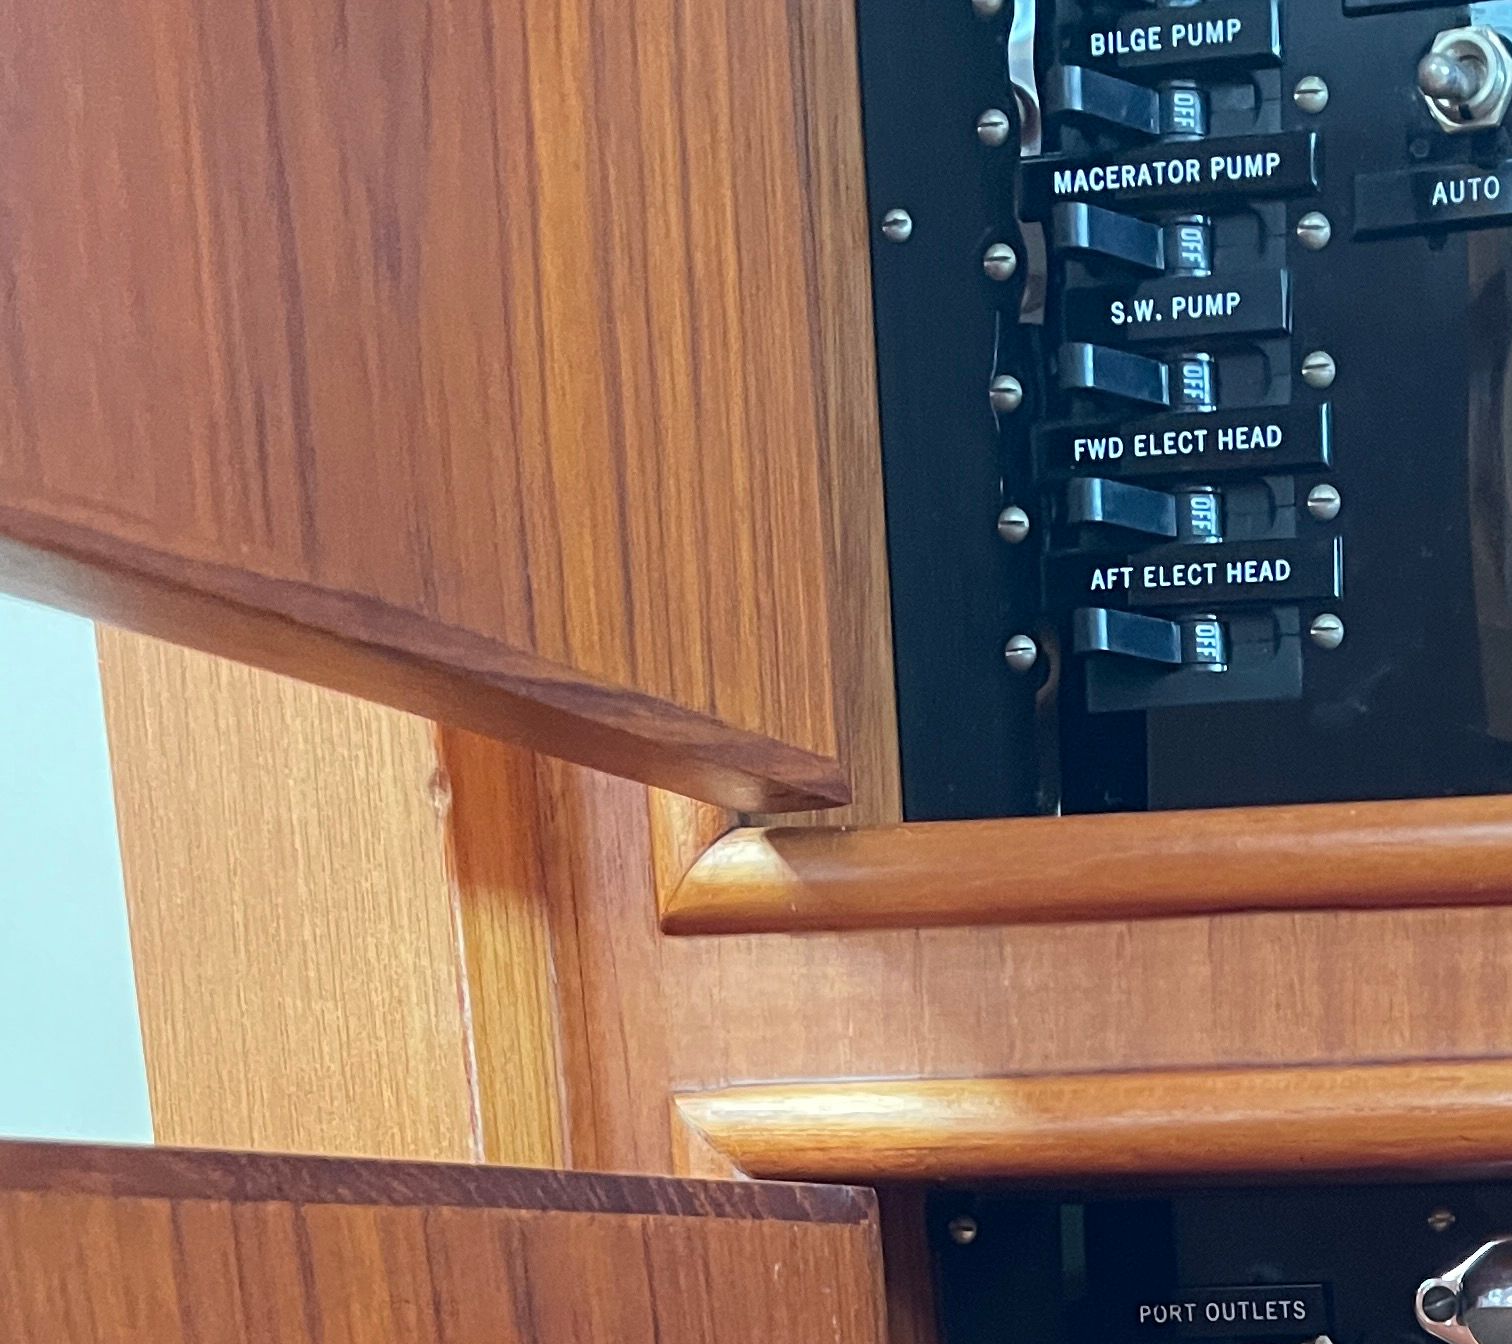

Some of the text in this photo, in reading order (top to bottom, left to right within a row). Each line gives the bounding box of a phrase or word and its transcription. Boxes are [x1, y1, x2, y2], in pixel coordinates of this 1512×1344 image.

[1091, 18, 1241, 57] BILGE PUMP
[1173, 92, 1196, 134] OFF
[1054, 153, 1281, 194] MACERATOR PUMP
[1432, 176, 1500, 206] AUTO
[1180, 228, 1201, 264] OFF
[1111, 293, 1241, 324] S.W. PUMP
[1183, 365, 1202, 399] OFF
[1074, 425, 1282, 461] FWD ELECT HEAD
[1190, 496, 1211, 535] OFF
[1090, 559, 1291, 590] AFT ELECT HEAD
[1195, 624, 1217, 661] OFF
[1140, 1301, 1306, 1323] PORT OUTLETS
